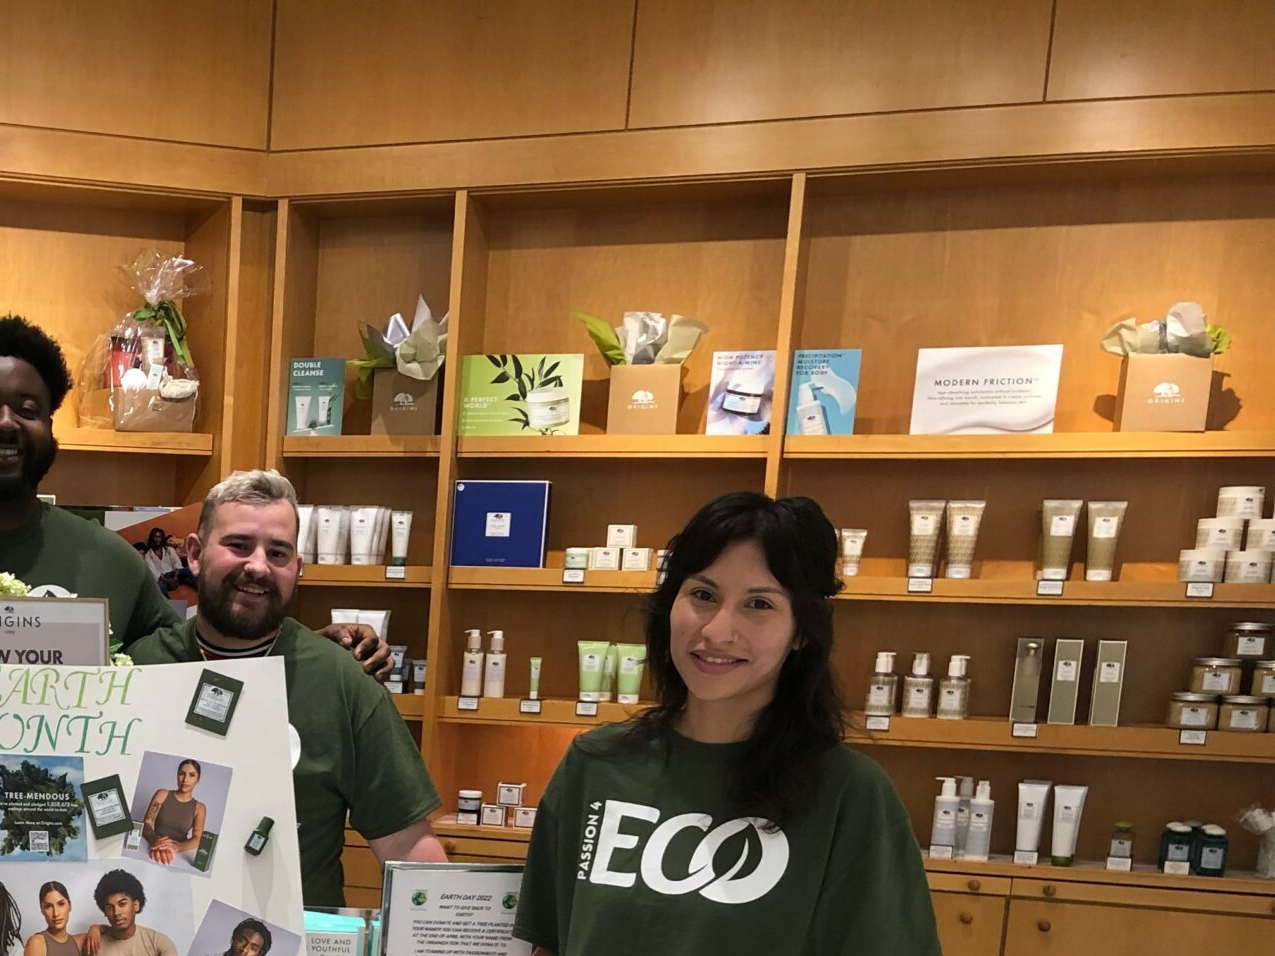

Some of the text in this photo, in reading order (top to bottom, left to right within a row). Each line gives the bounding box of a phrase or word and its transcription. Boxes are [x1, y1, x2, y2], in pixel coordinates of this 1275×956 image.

[934, 379, 979, 387] MODERN
[14, 650, 64, 665] YOUR
[5, 792, 69, 800] TREE-MENDOUS
[577, 800, 602, 880] PASSION 4
[589, 799, 790, 904] ECO
[311, 945, 350, 953] YOUTHFUL
